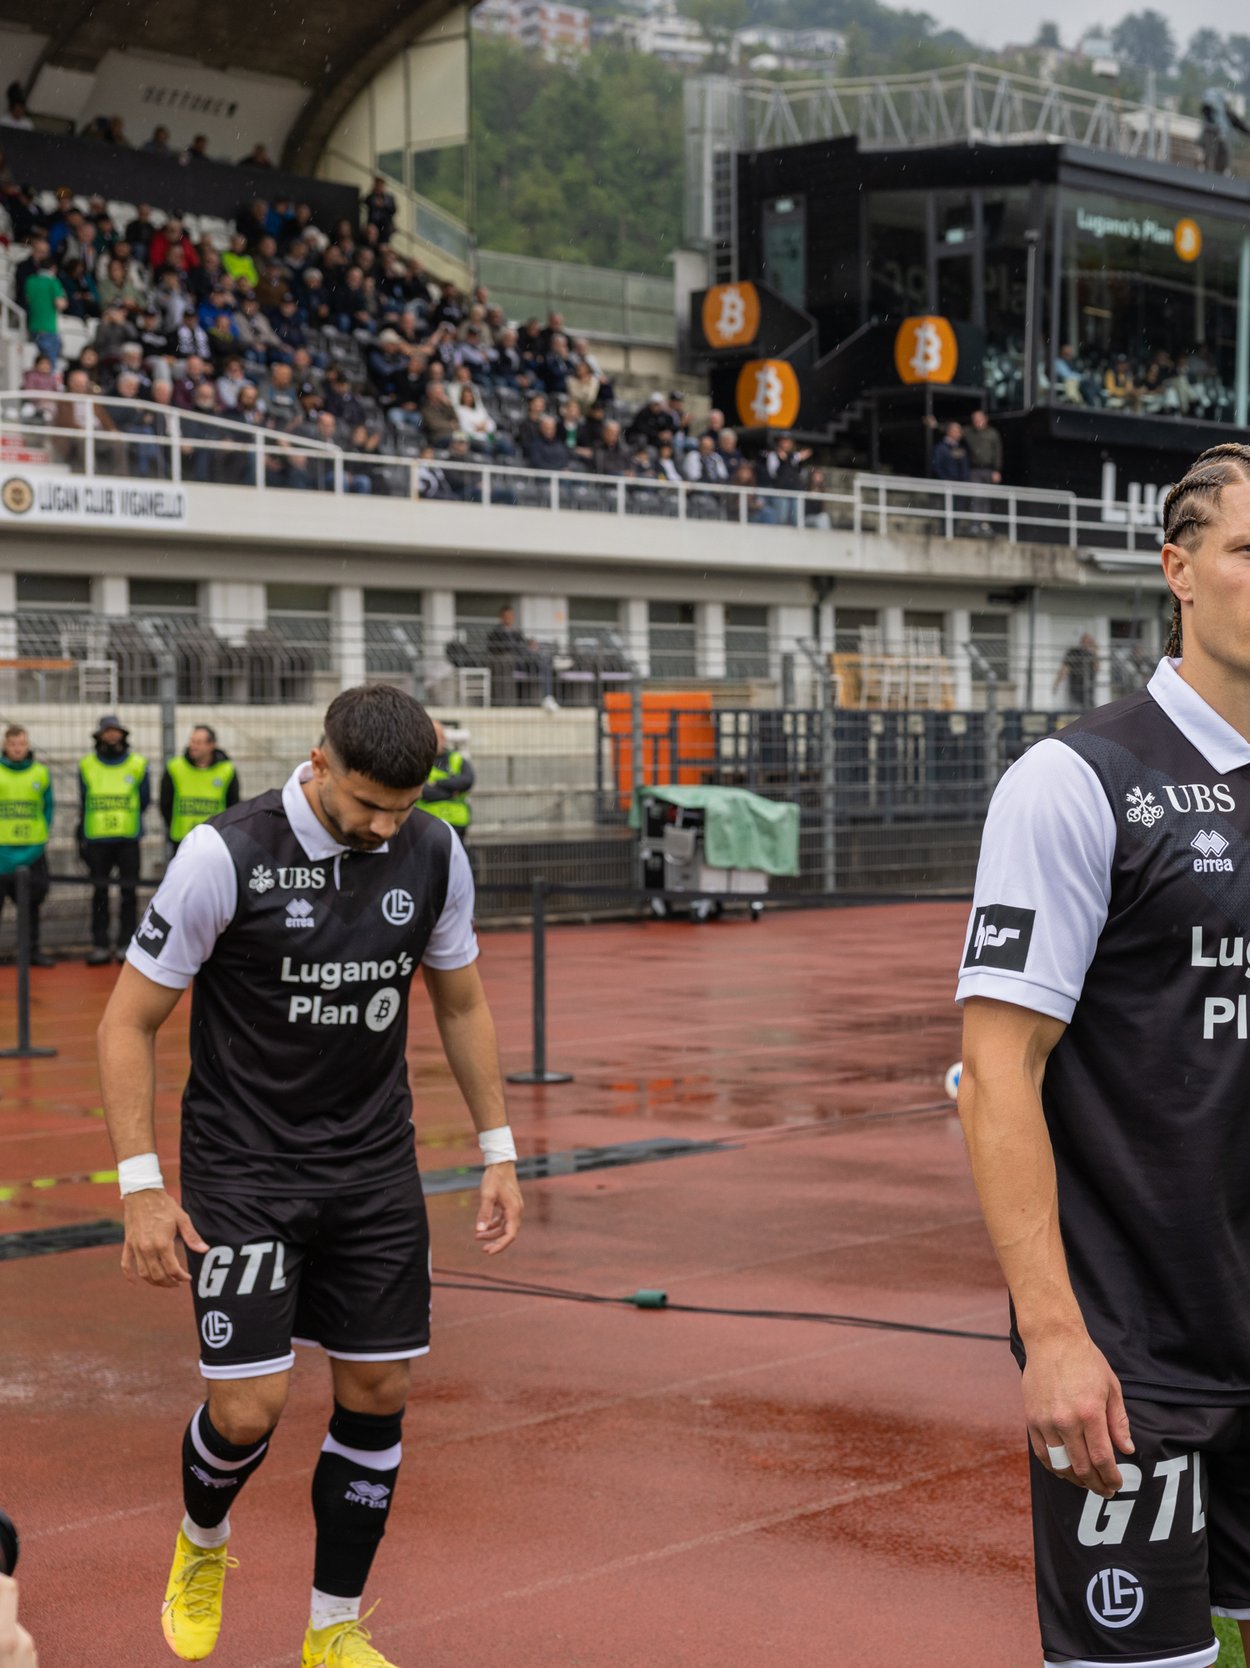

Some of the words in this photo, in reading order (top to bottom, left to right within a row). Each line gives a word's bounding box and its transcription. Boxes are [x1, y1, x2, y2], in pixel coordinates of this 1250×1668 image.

[1162, 783, 1236, 813] UBS
[277, 867, 326, 890] UBS
[280, 951, 413, 990] Lugano's
[287, 995, 359, 1025] Plan
